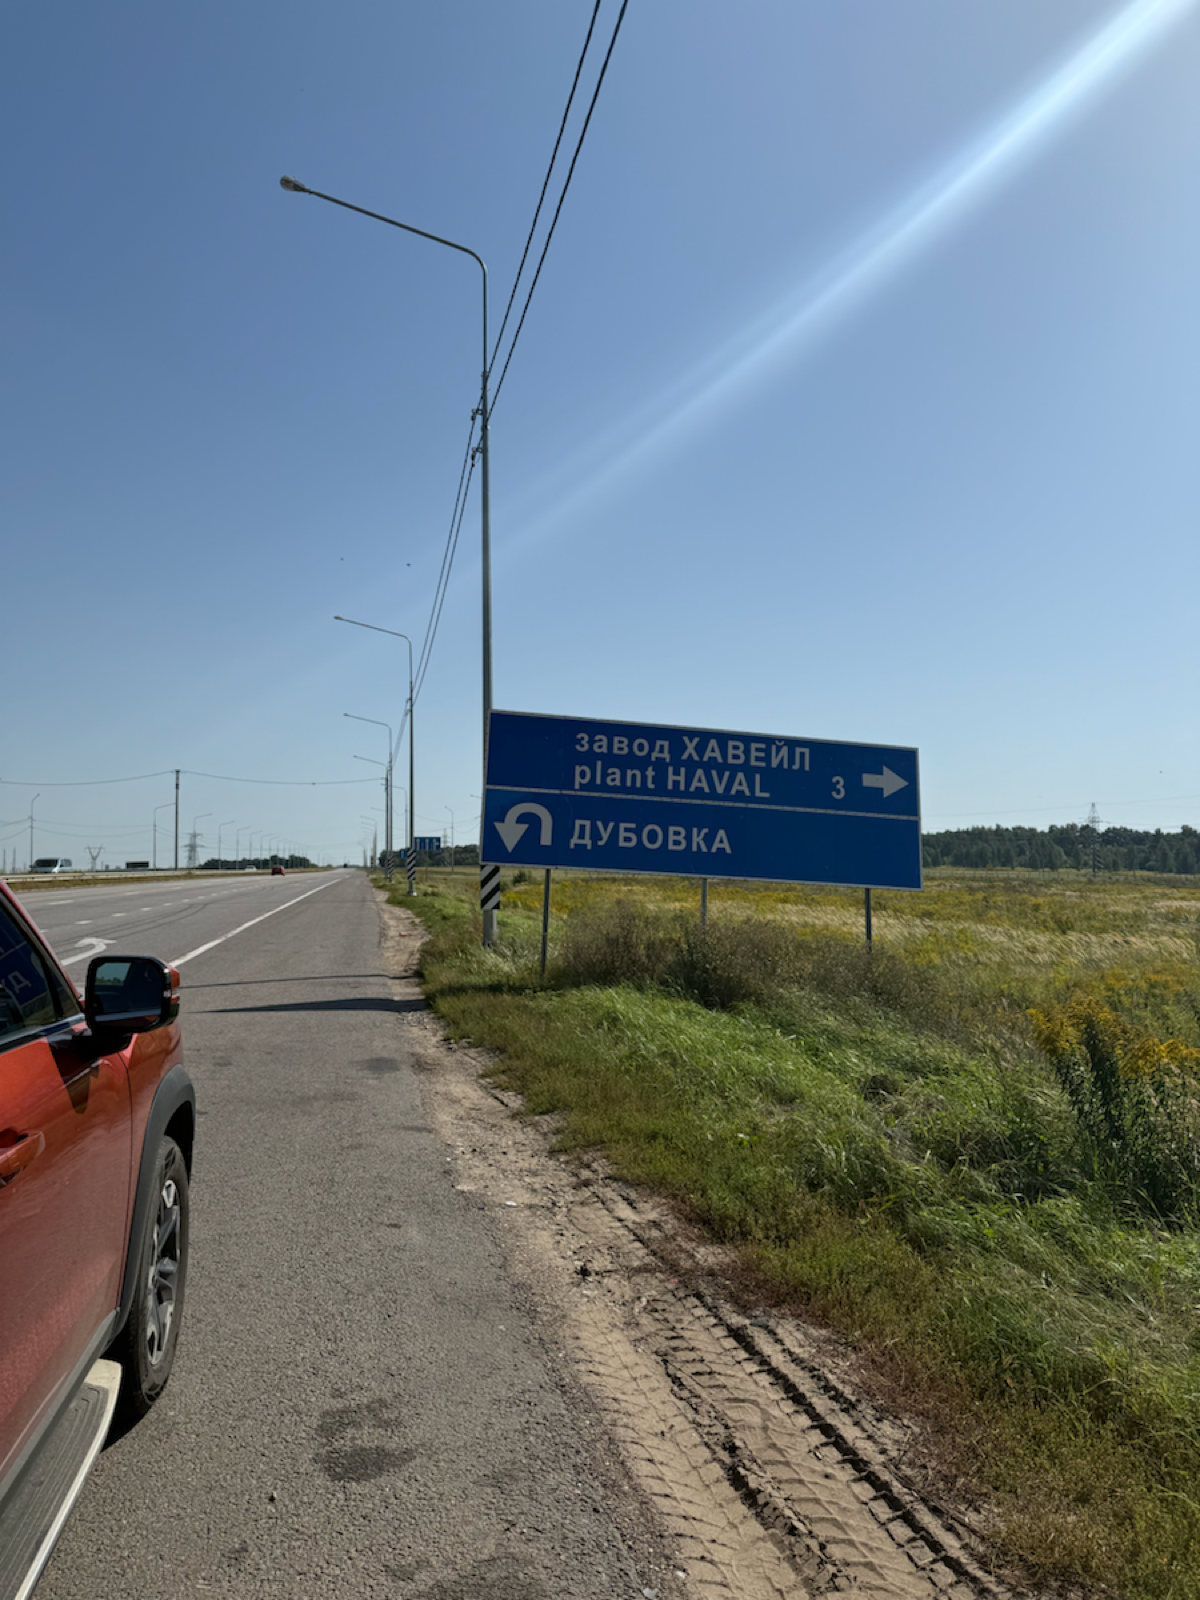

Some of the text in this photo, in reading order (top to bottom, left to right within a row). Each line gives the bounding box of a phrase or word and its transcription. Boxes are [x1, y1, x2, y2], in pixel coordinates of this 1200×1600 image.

[575, 733, 810, 771] завод ХАВЕЙЛ
[574, 760, 770, 798] plant HAVAL
[831, 775, 845, 799] 3
[570, 819, 732, 854] ДУБОВКА
